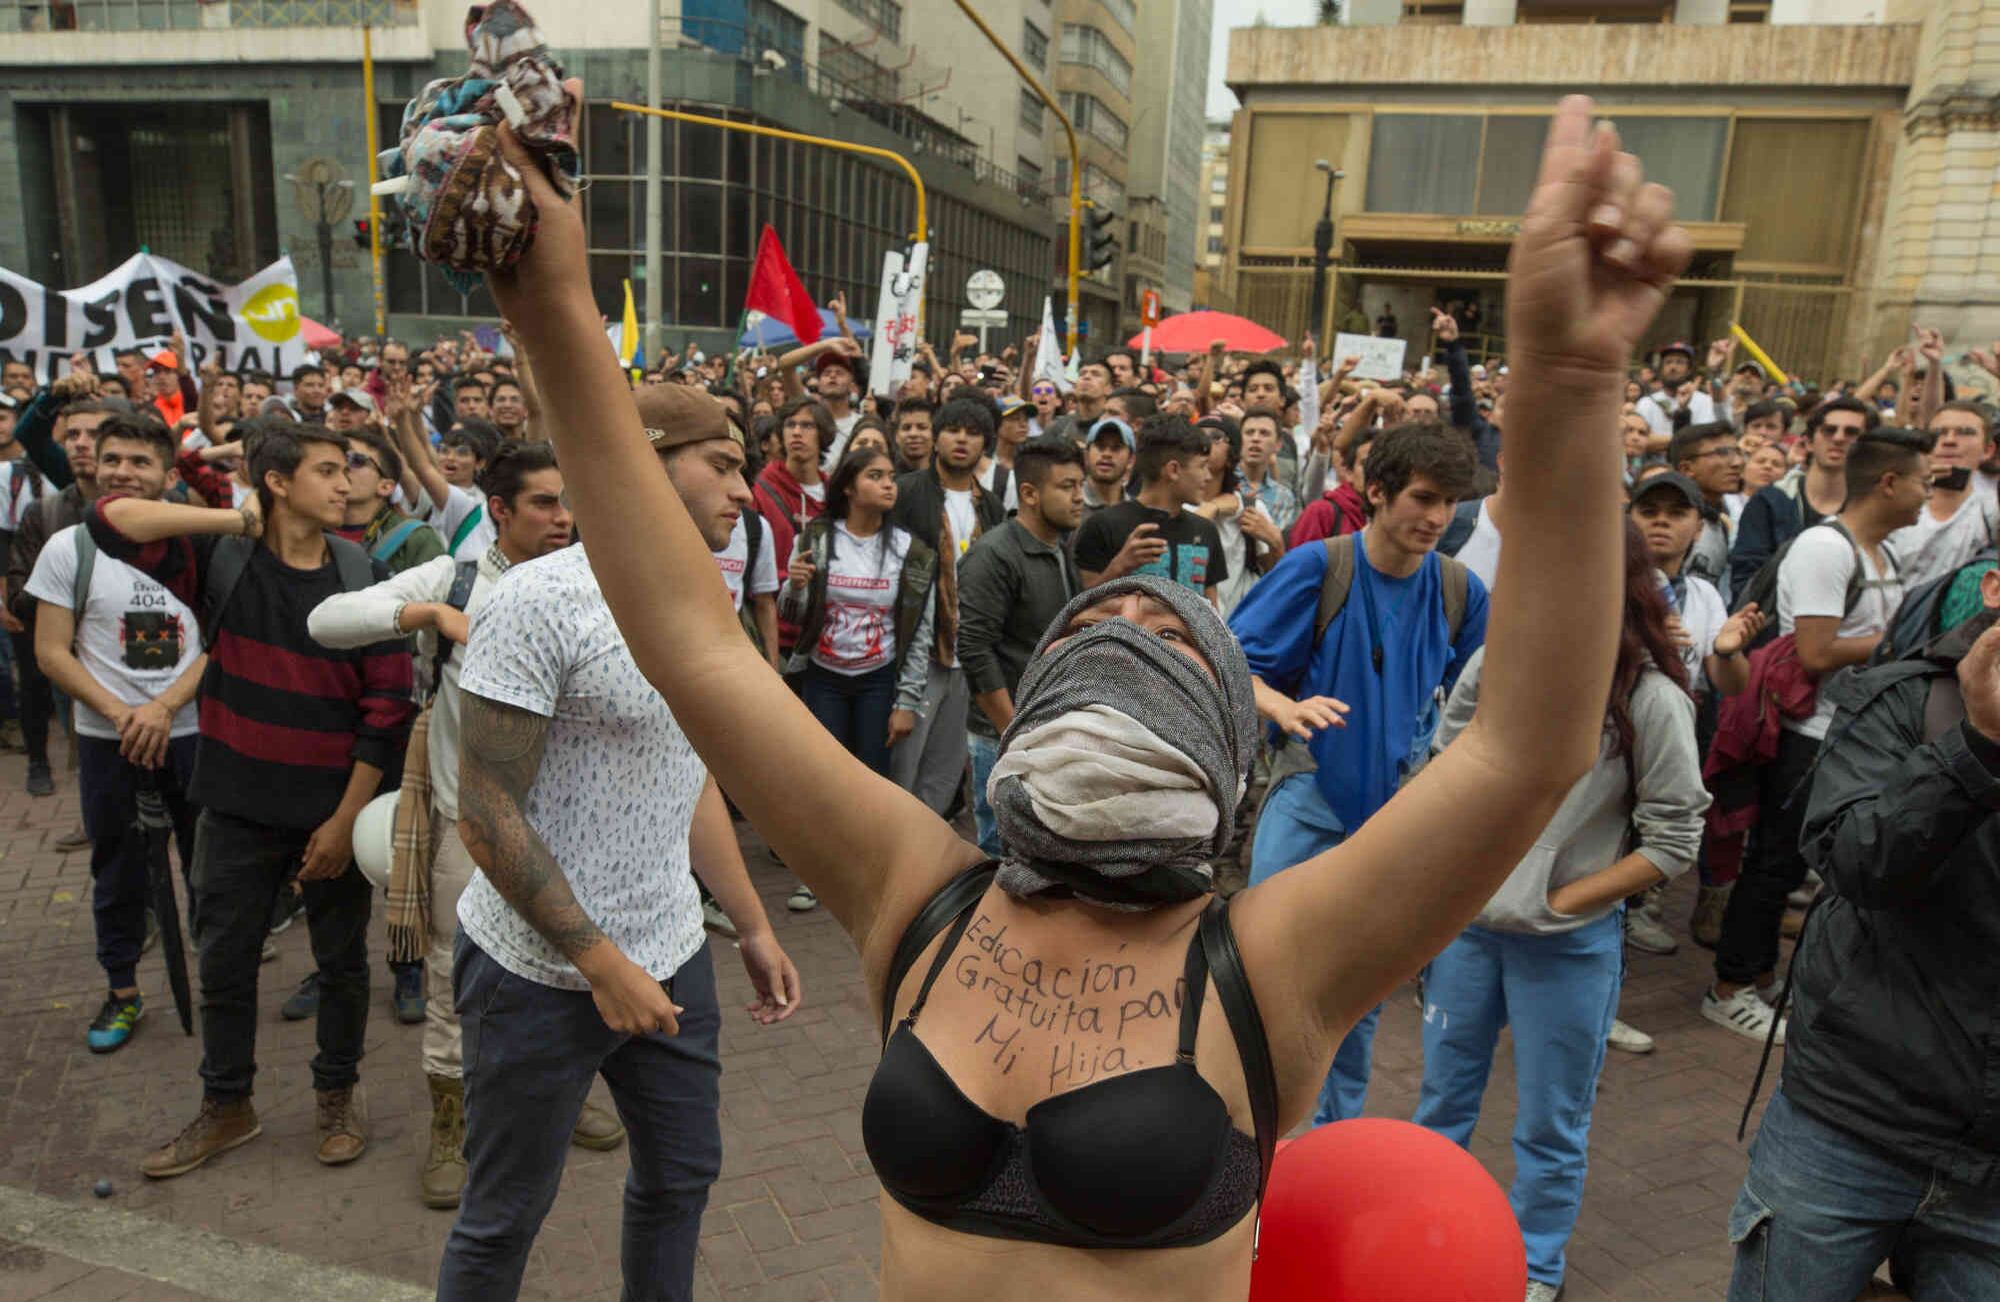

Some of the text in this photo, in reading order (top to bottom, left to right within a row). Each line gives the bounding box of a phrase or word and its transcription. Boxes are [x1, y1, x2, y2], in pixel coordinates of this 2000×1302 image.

[129, 593, 167, 608] 404
[965, 915, 1136, 999] Educación
[956, 955, 1103, 1034] Gratuita
[975, 1013, 1025, 1075] Mi
